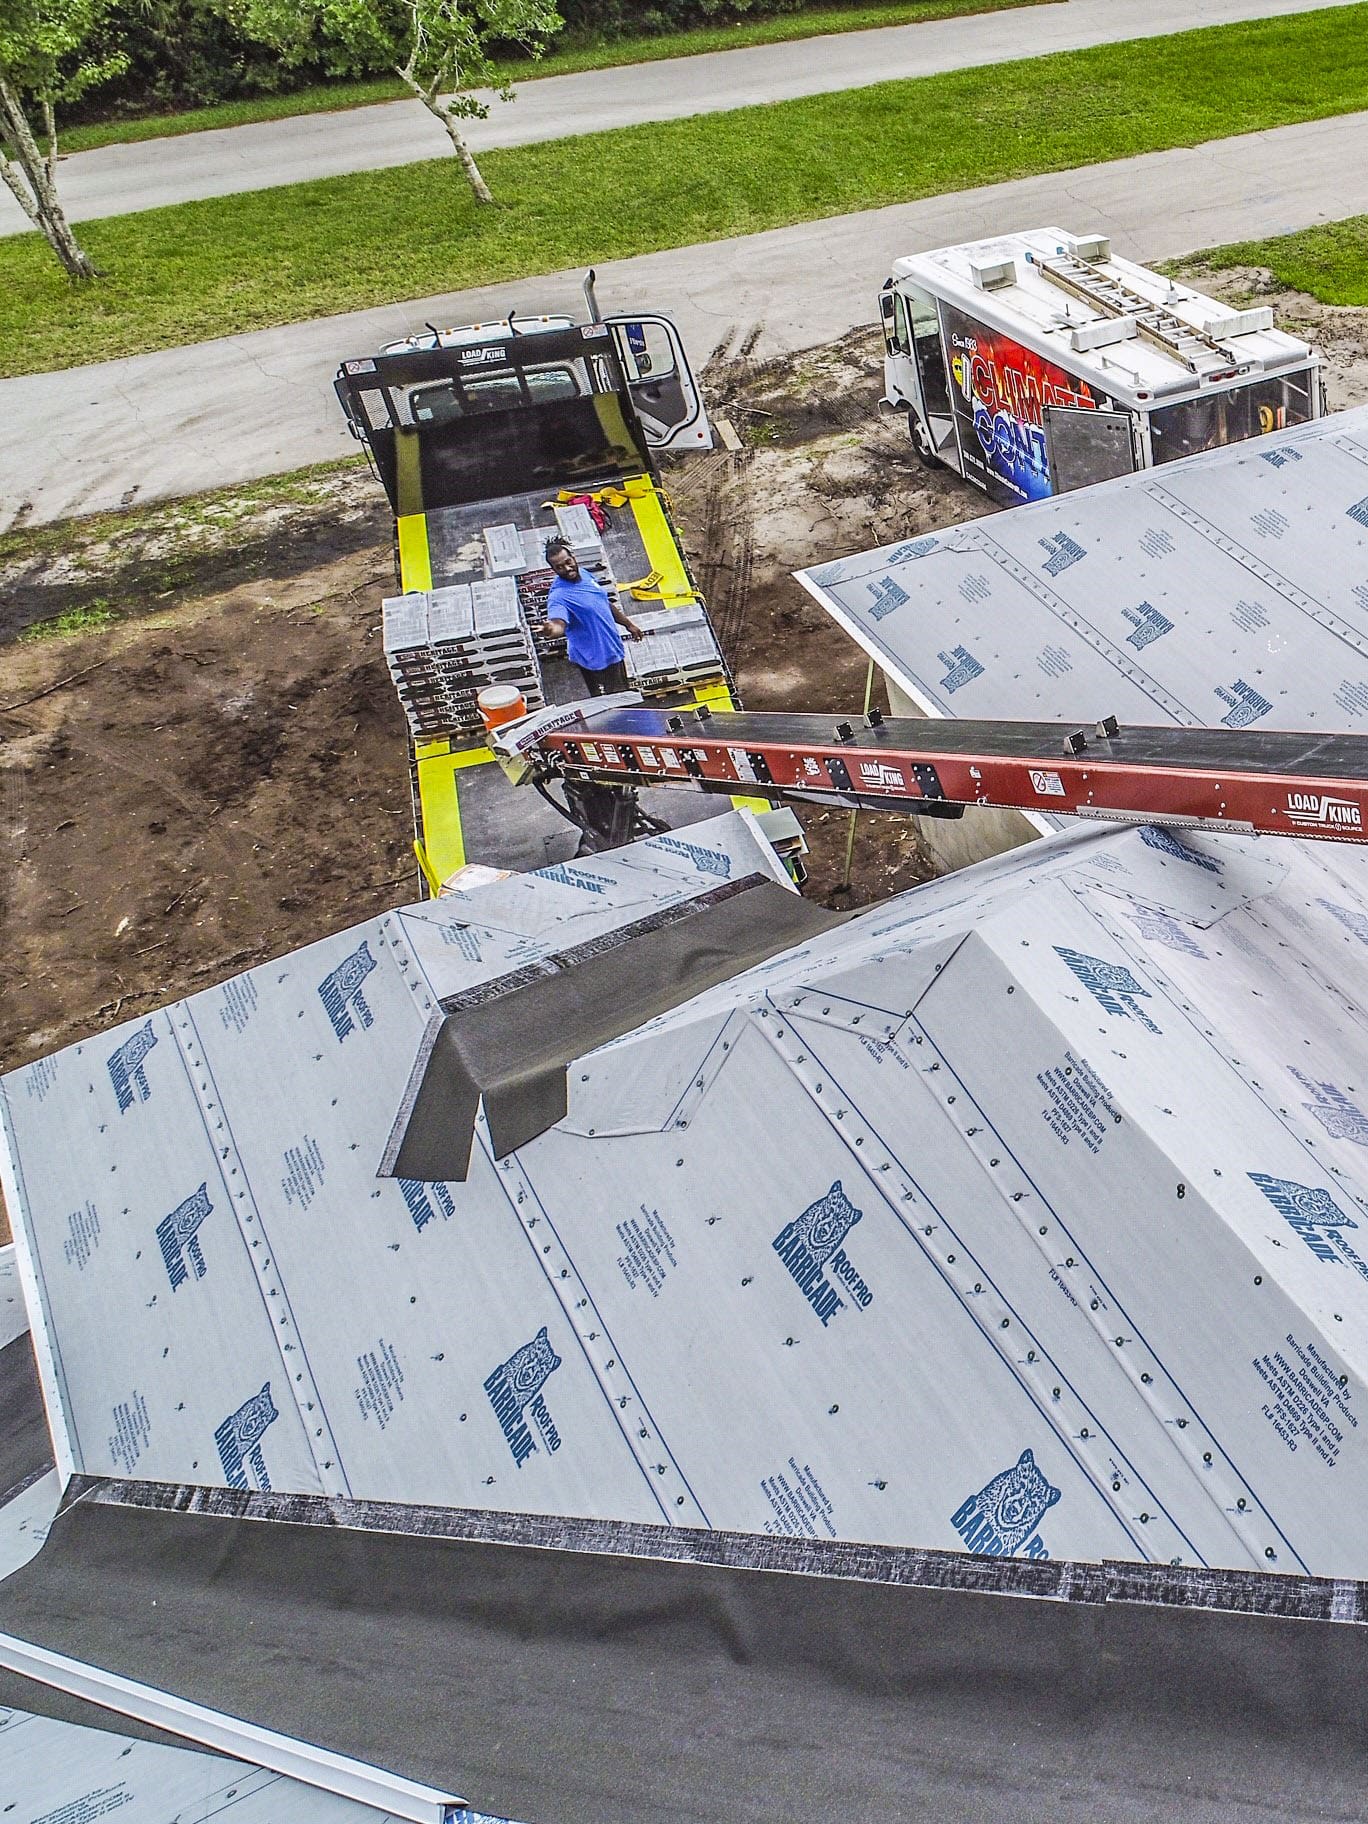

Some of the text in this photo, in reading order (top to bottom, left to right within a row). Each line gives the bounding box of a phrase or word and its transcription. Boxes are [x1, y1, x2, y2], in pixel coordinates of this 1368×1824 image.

[462, 349, 506, 360] LOAD KING
[420, 646, 457, 657] HERITAGE
[537, 713, 576, 735] HERITAGE
[860, 763, 905, 786] LOAD KING
[1287, 793, 1361, 824] LOAD KING
[318, 973, 355, 1044] BARRICADE
[1052, 945, 1133, 1020] BARRICADE
[1246, 1172, 1344, 1263] BARRICADE
[1322, 1228, 1360, 1261] ROOF
[156, 1213, 189, 1293] BARRICADE
[772, 1222, 844, 1328] BARRICADE
[830, 1248, 874, 1307] ROOF PRO
[1273, 1352, 1344, 1443] WWW.BARRICADEBP.COM
[1286, 1334, 1358, 1428] Barricade Building Products
[1298, 1368, 1330, 1408] Doswell VA
[1307, 1343, 1352, 1401] Manufactured by
[483, 1364, 537, 1469] BARRICADE
[529, 1393, 561, 1451] ROOF PRO
[1252, 1358, 1269, 1380] Meets
[1267, 1379, 1285, 1402] ASTM
[1282, 1399, 1301, 1421] D4869
[1299, 1419, 1313, 1440] Type
[1316, 1443, 1329, 1460] and
[1326, 1456, 1336, 1467] IV
[1262, 1355, 1279, 1377] Meets
[1277, 1375, 1296, 1398] ASTM
[1292, 1395, 1309, 1415] D226
[1306, 1412, 1320, 1432] Type
[1322, 1434, 1335, 1450] and
[1273, 1403, 1300, 1436] PFS-1627
[1272, 1418, 1298, 1452] 16453-R3
